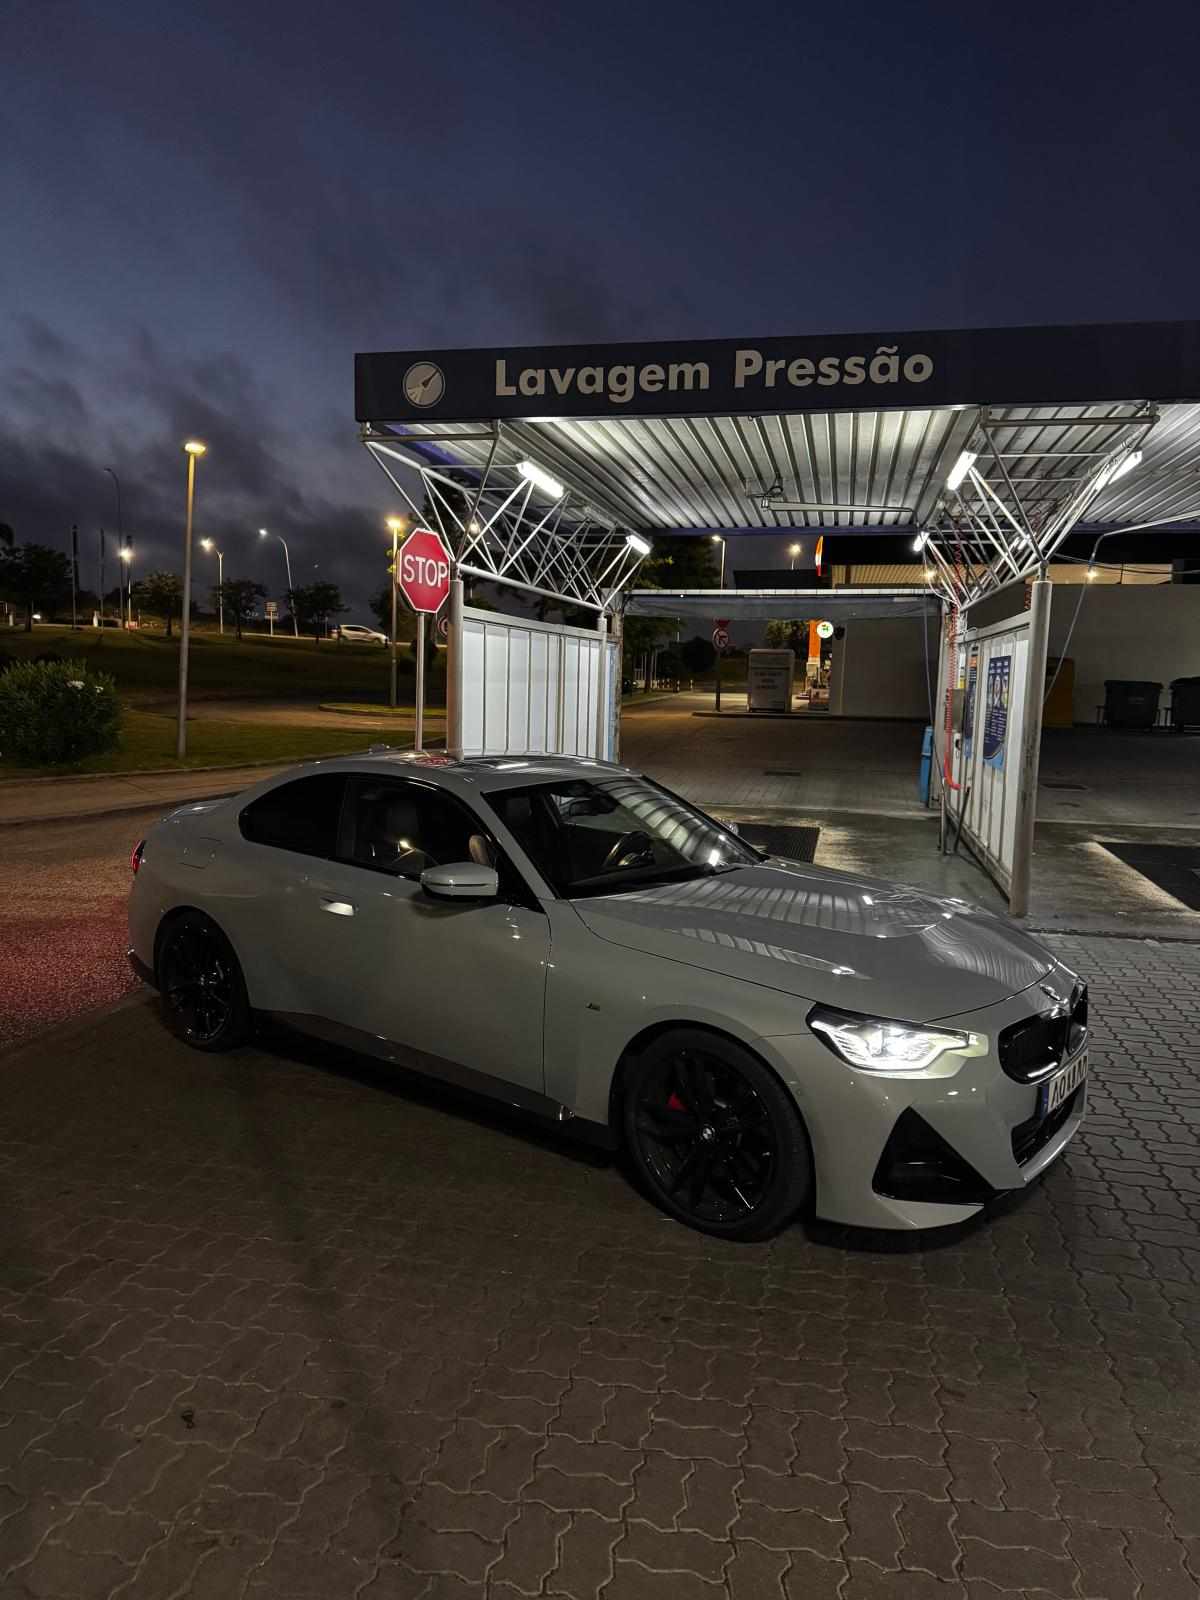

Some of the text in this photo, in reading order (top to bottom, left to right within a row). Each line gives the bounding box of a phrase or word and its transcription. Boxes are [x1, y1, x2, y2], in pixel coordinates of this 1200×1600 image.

[494, 346, 934, 403] Lavagem Pressão
[403, 554, 448, 588] STOP
